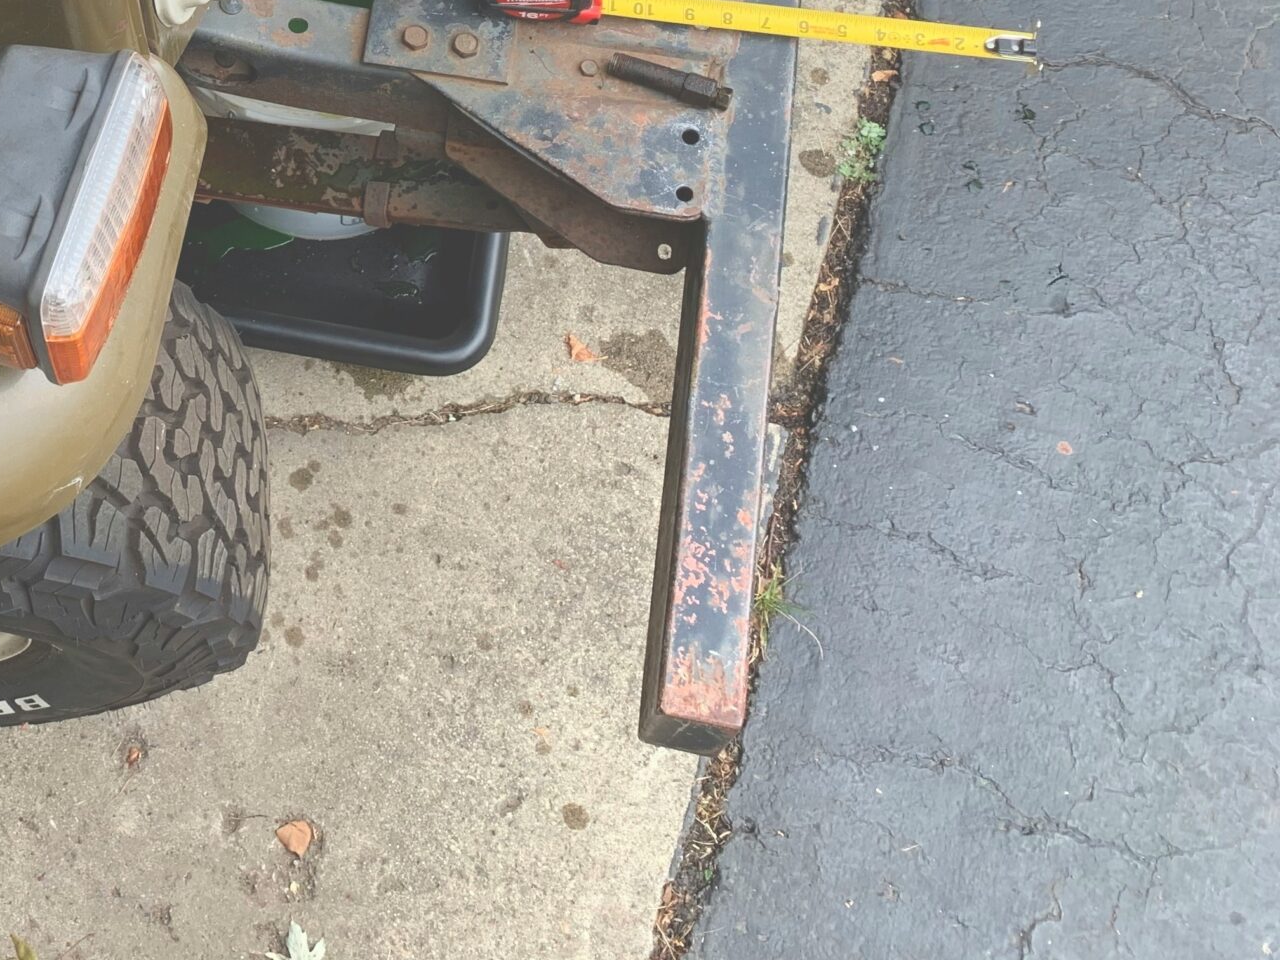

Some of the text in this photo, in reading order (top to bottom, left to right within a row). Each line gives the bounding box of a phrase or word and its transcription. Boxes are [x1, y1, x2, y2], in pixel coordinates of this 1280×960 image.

[519, 11, 538, 20] 16
[633, 2, 654, 16] 10
[684, 8, 695, 21] 9
[723, 12, 733, 25] 8
[760, 17, 771, 29] 7
[798, 21, 809, 34] 6
[837, 25, 848, 38] 5
[876, 28, 886, 42] 4
[915, 33, 925, 46] 3
[954, 38, 965, 51] 2
